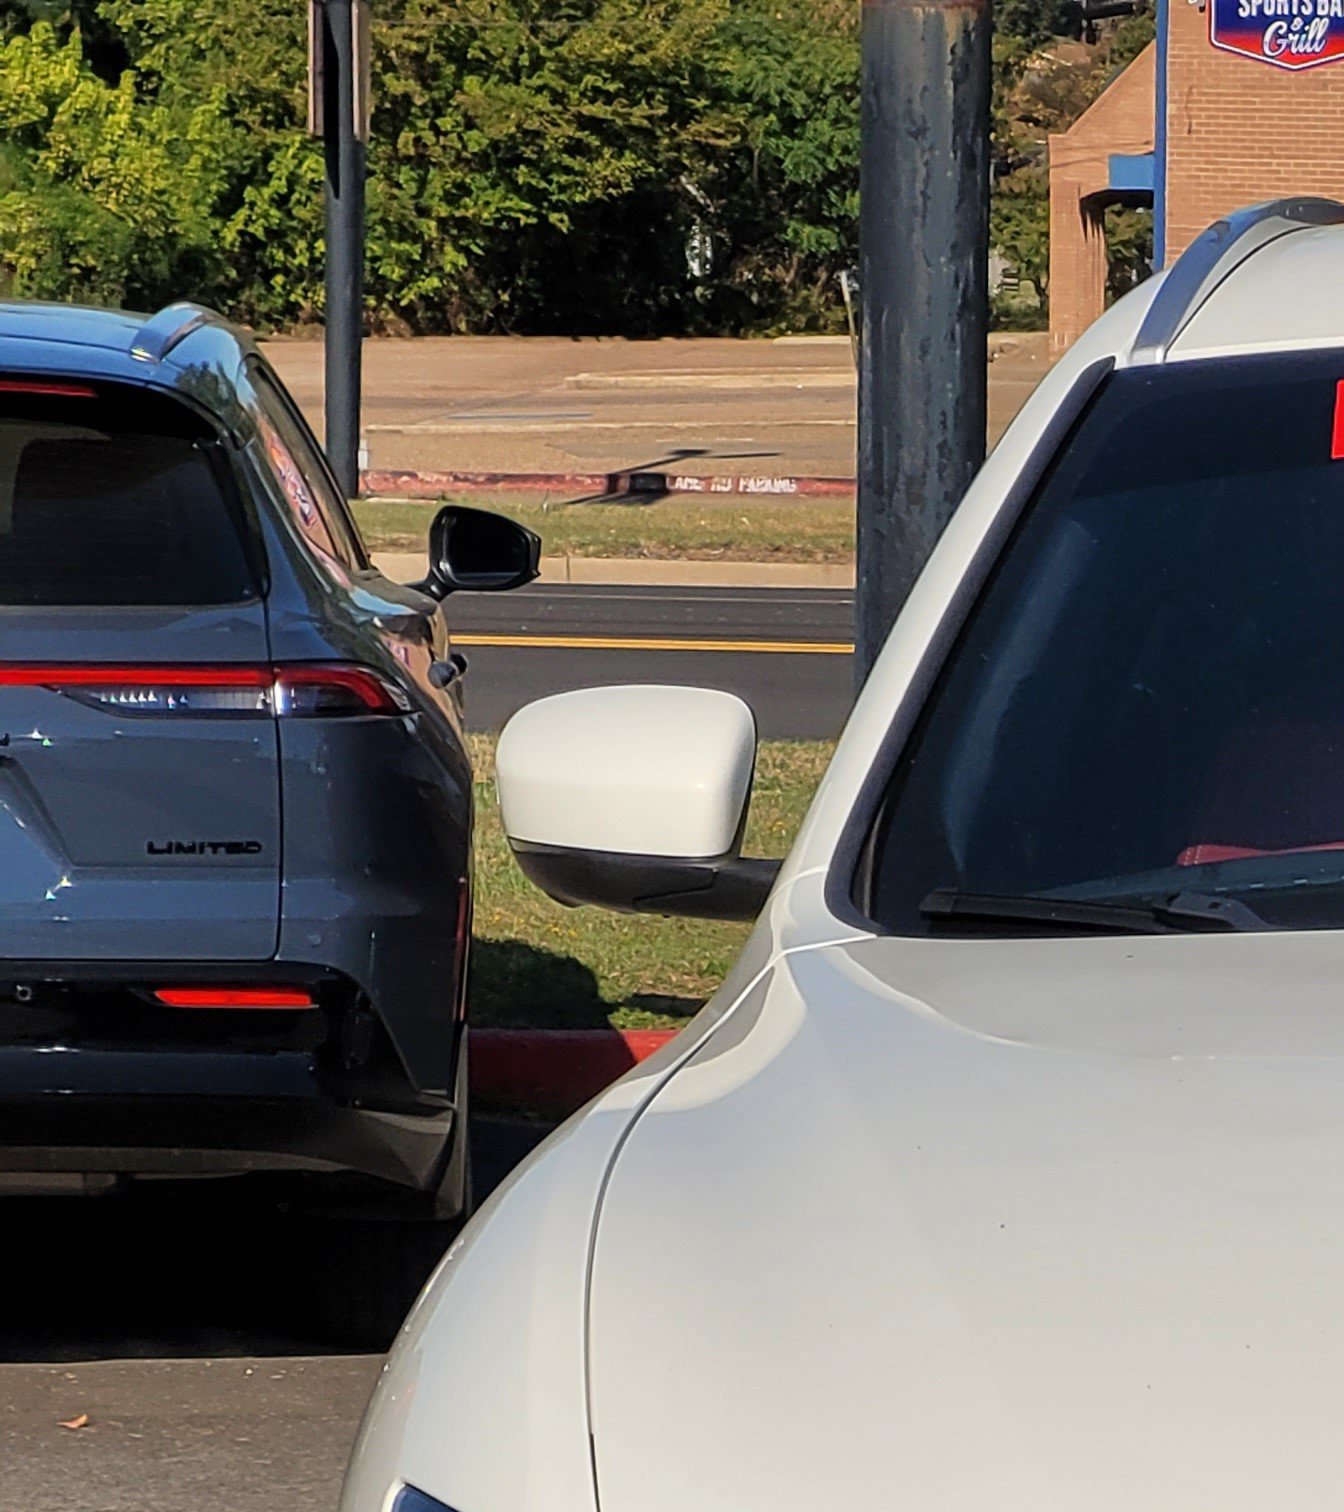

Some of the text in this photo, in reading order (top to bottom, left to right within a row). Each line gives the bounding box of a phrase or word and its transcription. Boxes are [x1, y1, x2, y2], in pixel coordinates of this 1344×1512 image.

[1238, 0, 1313, 18] SPORTS
[1263, 17, 1330, 57] Grill
[738, 477, 798, 493] PARKING
[146, 840, 263, 855] LIMITED
